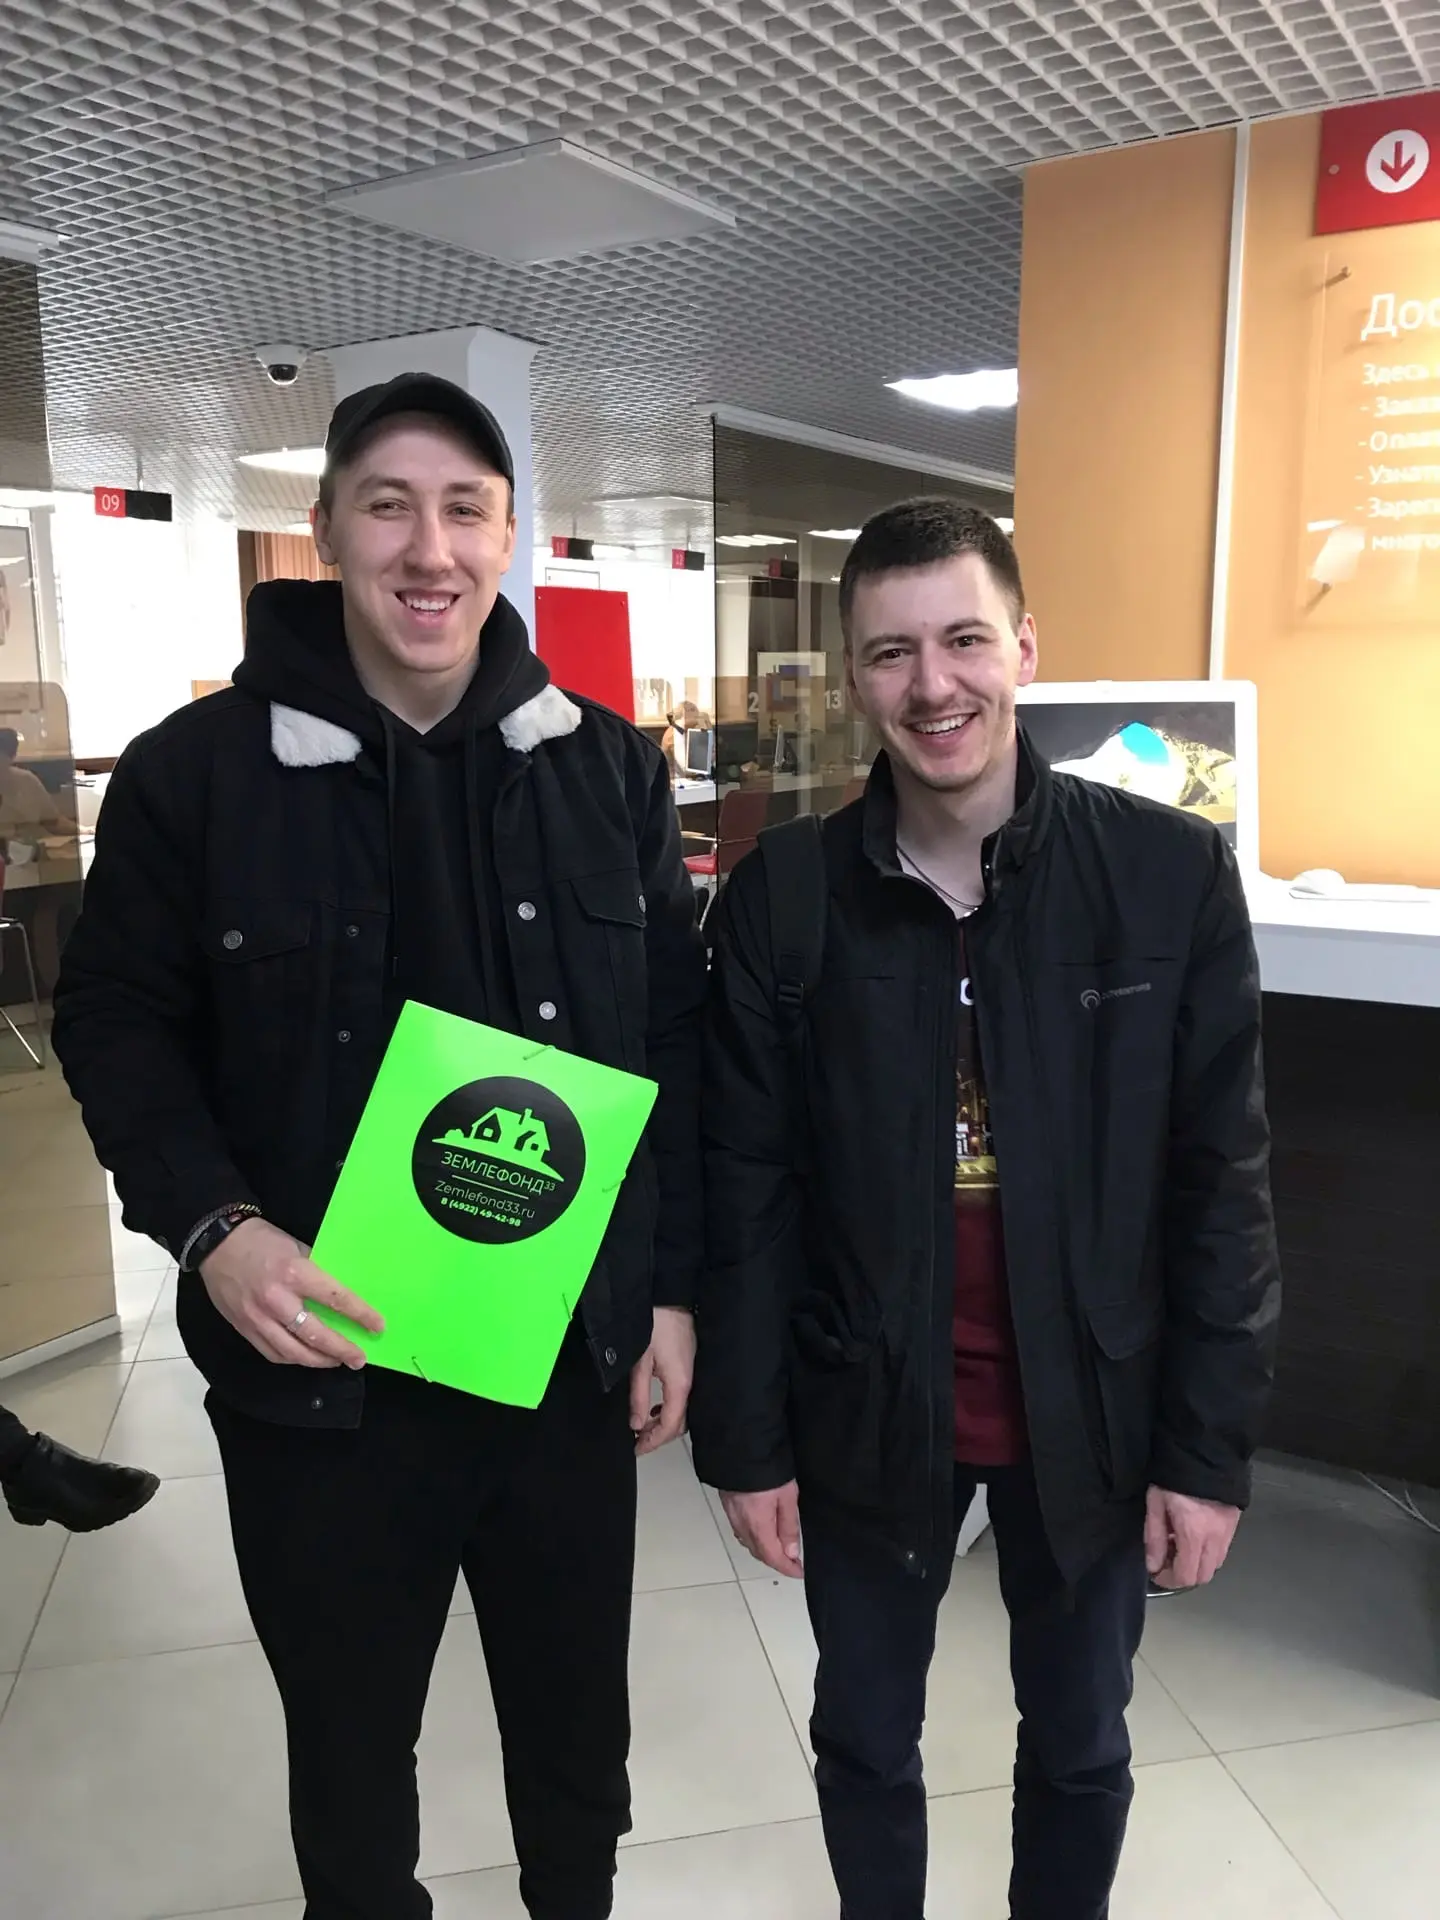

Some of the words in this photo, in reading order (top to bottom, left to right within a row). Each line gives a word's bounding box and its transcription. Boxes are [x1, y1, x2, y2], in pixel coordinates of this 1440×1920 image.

[101, 494, 120, 511] 09
[824, 689, 842, 710] 13
[435, 1180, 535, 1219] Zemlefond33.ru
[440, 1197, 448, 1206] 8
[449, 1199, 479, 1216] (4922)
[479, 1209, 522, 1227] 49-42-98
